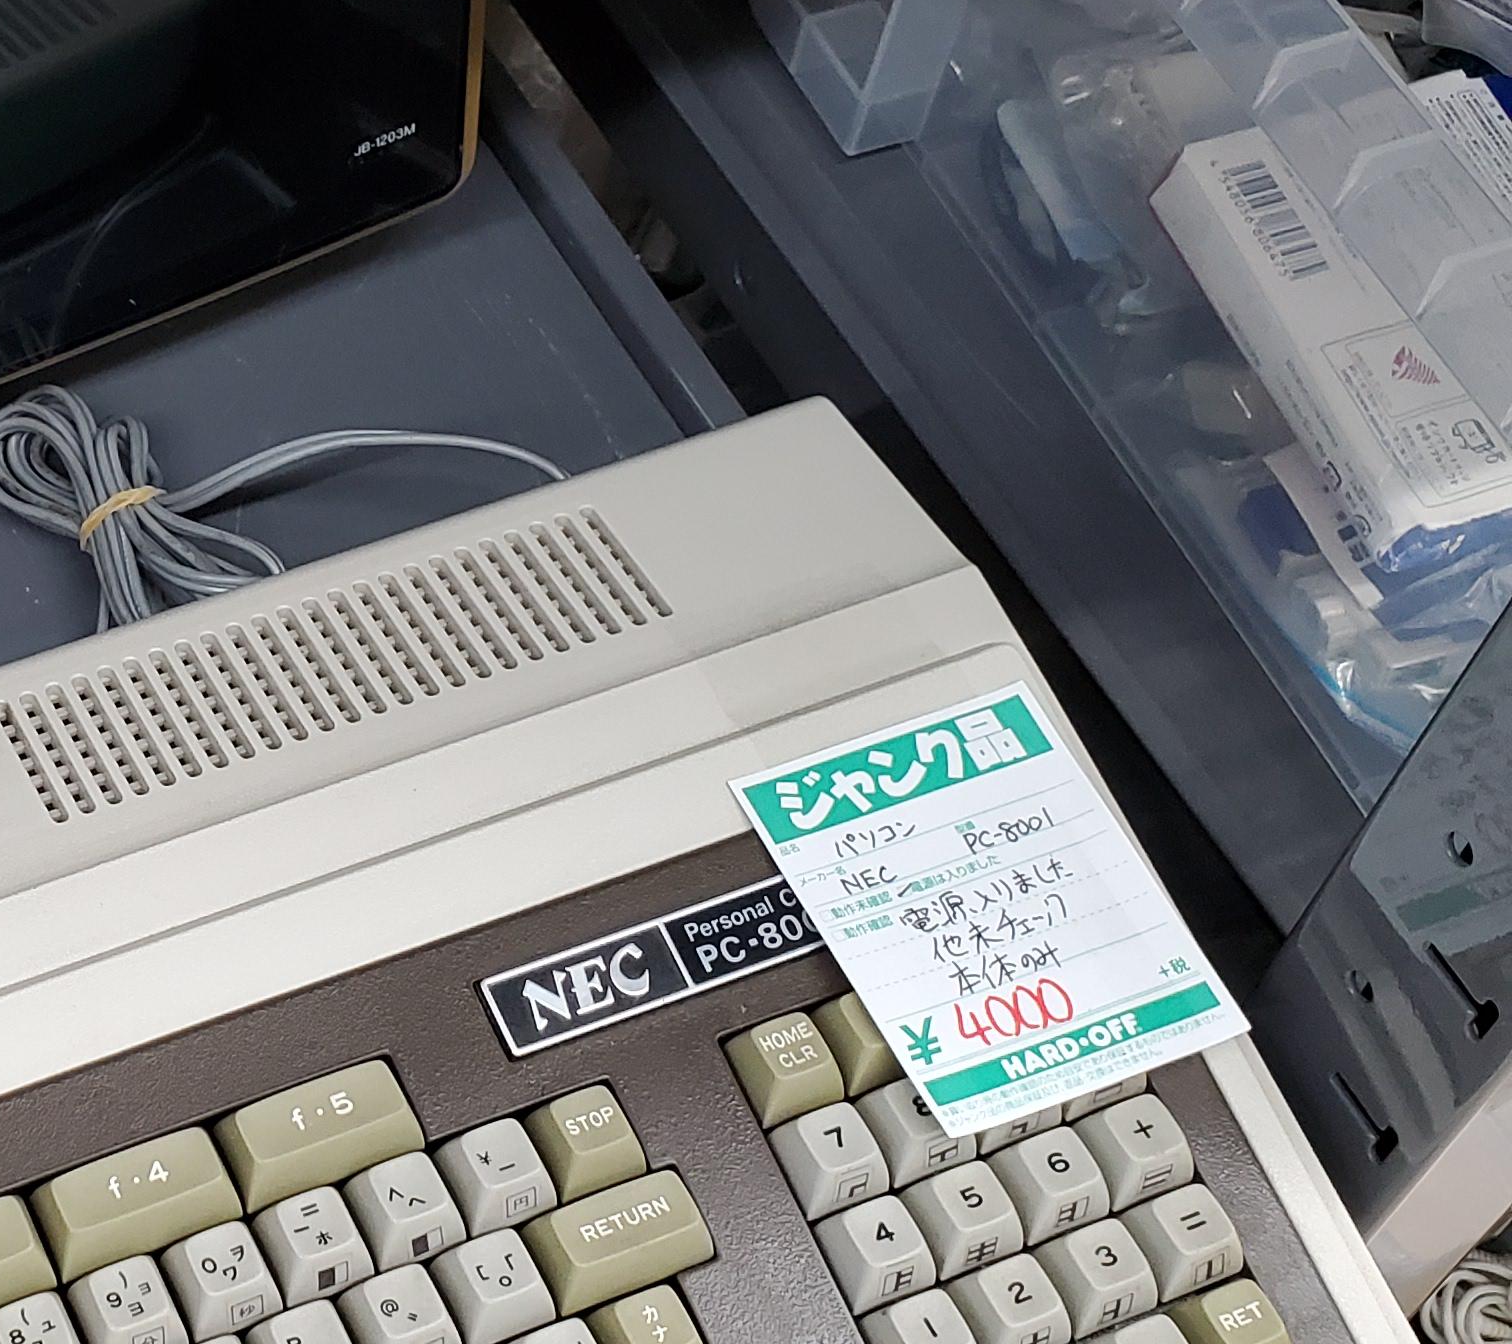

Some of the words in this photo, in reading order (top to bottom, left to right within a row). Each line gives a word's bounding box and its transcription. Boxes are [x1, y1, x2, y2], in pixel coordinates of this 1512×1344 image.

[353, 122, 416, 158] JB-1203M
[775, 708, 1027, 831] ジャンク品
[835, 822, 915, 857] パソコン
[963, 807, 1054, 854] PC-8001
[779, 843, 800, 856] 品名
[800, 866, 846, 887] メーカー名
[840, 866, 897, 895] NEC
[683, 896, 773, 942] Personal
[831, 891, 892, 918] 動作未確認
[844, 915, 893, 938] 動作確認
[950, 941, 1061, 996] 本体のみ
[522, 943, 650, 1031] NEC
[900, 1017, 942, 1065] ¥
[955, 978, 1073, 1046] 4000
[758, 1020, 814, 1053] HOME
[778, 1044, 818, 1069] CLR
[565, 1106, 614, 1137] STOP
[824, 1125, 843, 1148] 7
[1046, 1152, 1070, 1173] 6
[959, 1185, 983, 1208] 5
[579, 1196, 670, 1242] RETURN
[875, 1222, 895, 1242] 4
[1094, 1245, 1118, 1267] 3
[106, 1291, 123, 1310] 9
[1007, 1281, 1033, 1304] 2
[1218, 1301, 1263, 1332] RET
